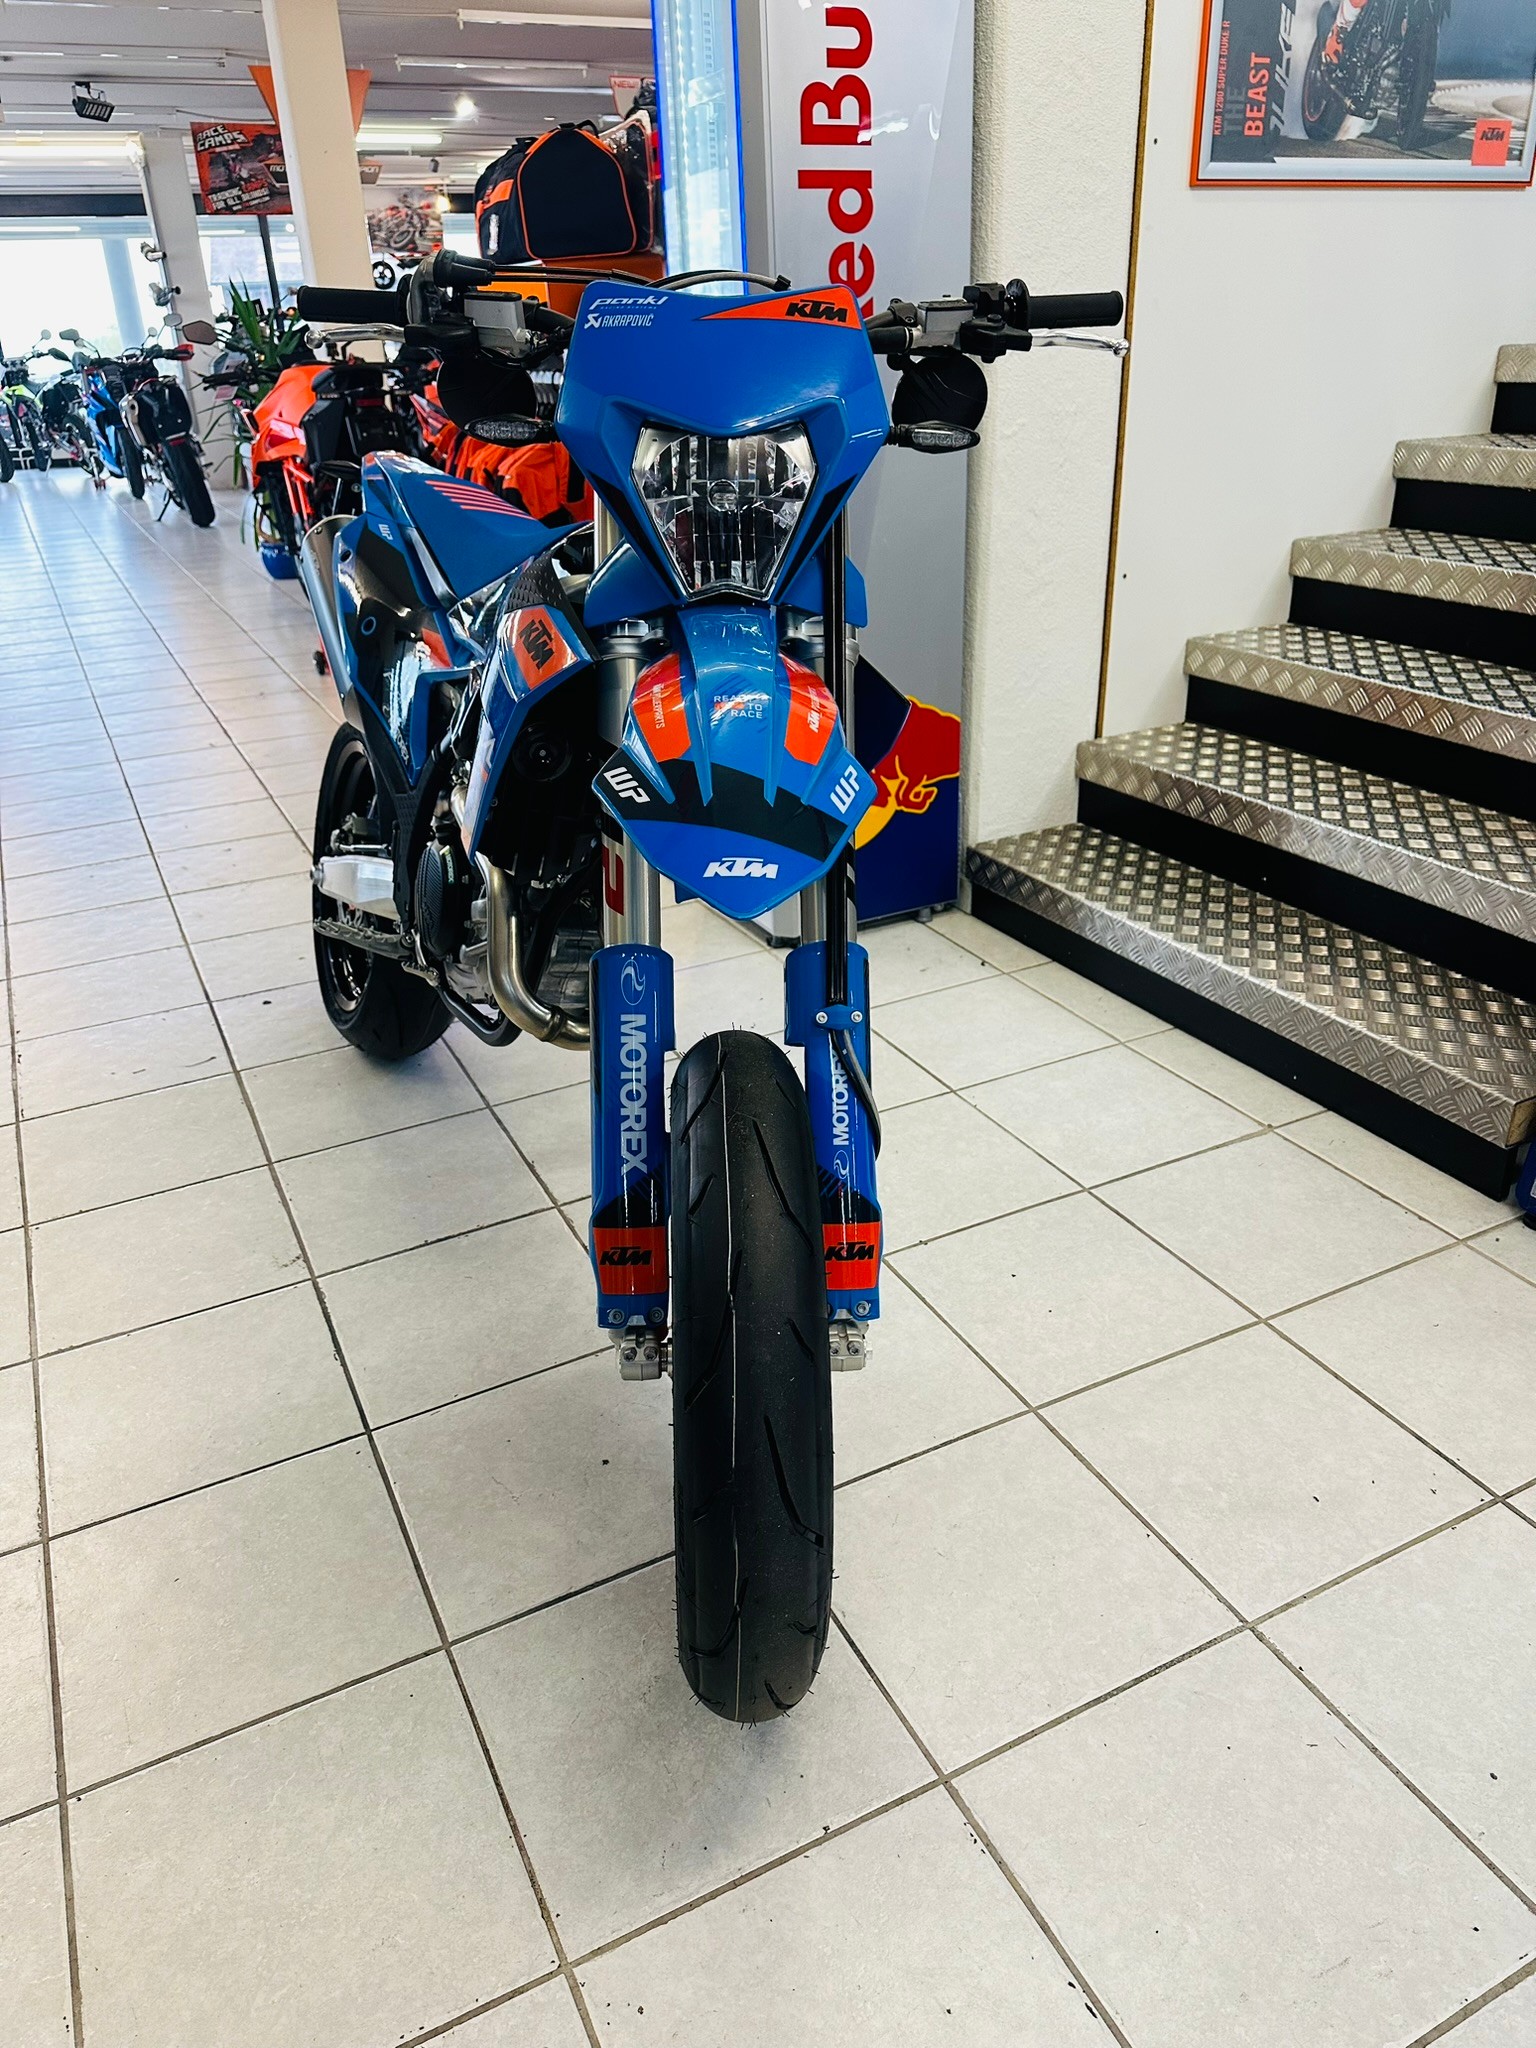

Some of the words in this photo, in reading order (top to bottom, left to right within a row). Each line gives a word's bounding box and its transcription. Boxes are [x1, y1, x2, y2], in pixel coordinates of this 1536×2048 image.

[1222, 20, 1231, 28] R
[1220, 30, 1230, 56] DUKE
[800, 6, 873, 146] Bu
[1217, 57, 1228, 89] SUPER
[1243, 51, 1271, 137] BEAST
[1223, 85, 1247, 136] THE
[196, 124, 229, 142] RACE
[1213, 116, 1223, 136] KTM
[1479, 127, 1505, 141] KTM
[196, 131, 248, 151] CAMPS
[798, 170, 875, 318] ed
[589, 295, 669, 310] pankl
[785, 298, 848, 323] KTM
[378, 523, 394, 541] WP
[519, 618, 555, 671] KTM
[731, 709, 763, 719] RACE
[748, 702, 763, 711] TO
[807, 709, 823, 734] KTM
[603, 766, 651, 804] WP
[830, 764, 859, 815] WP
[702, 856, 780, 879] KTM
[619, 1013, 648, 1177] MOTOREX
[599, 1245, 652, 1266] KTM
[824, 1241, 875, 1261] KTM
